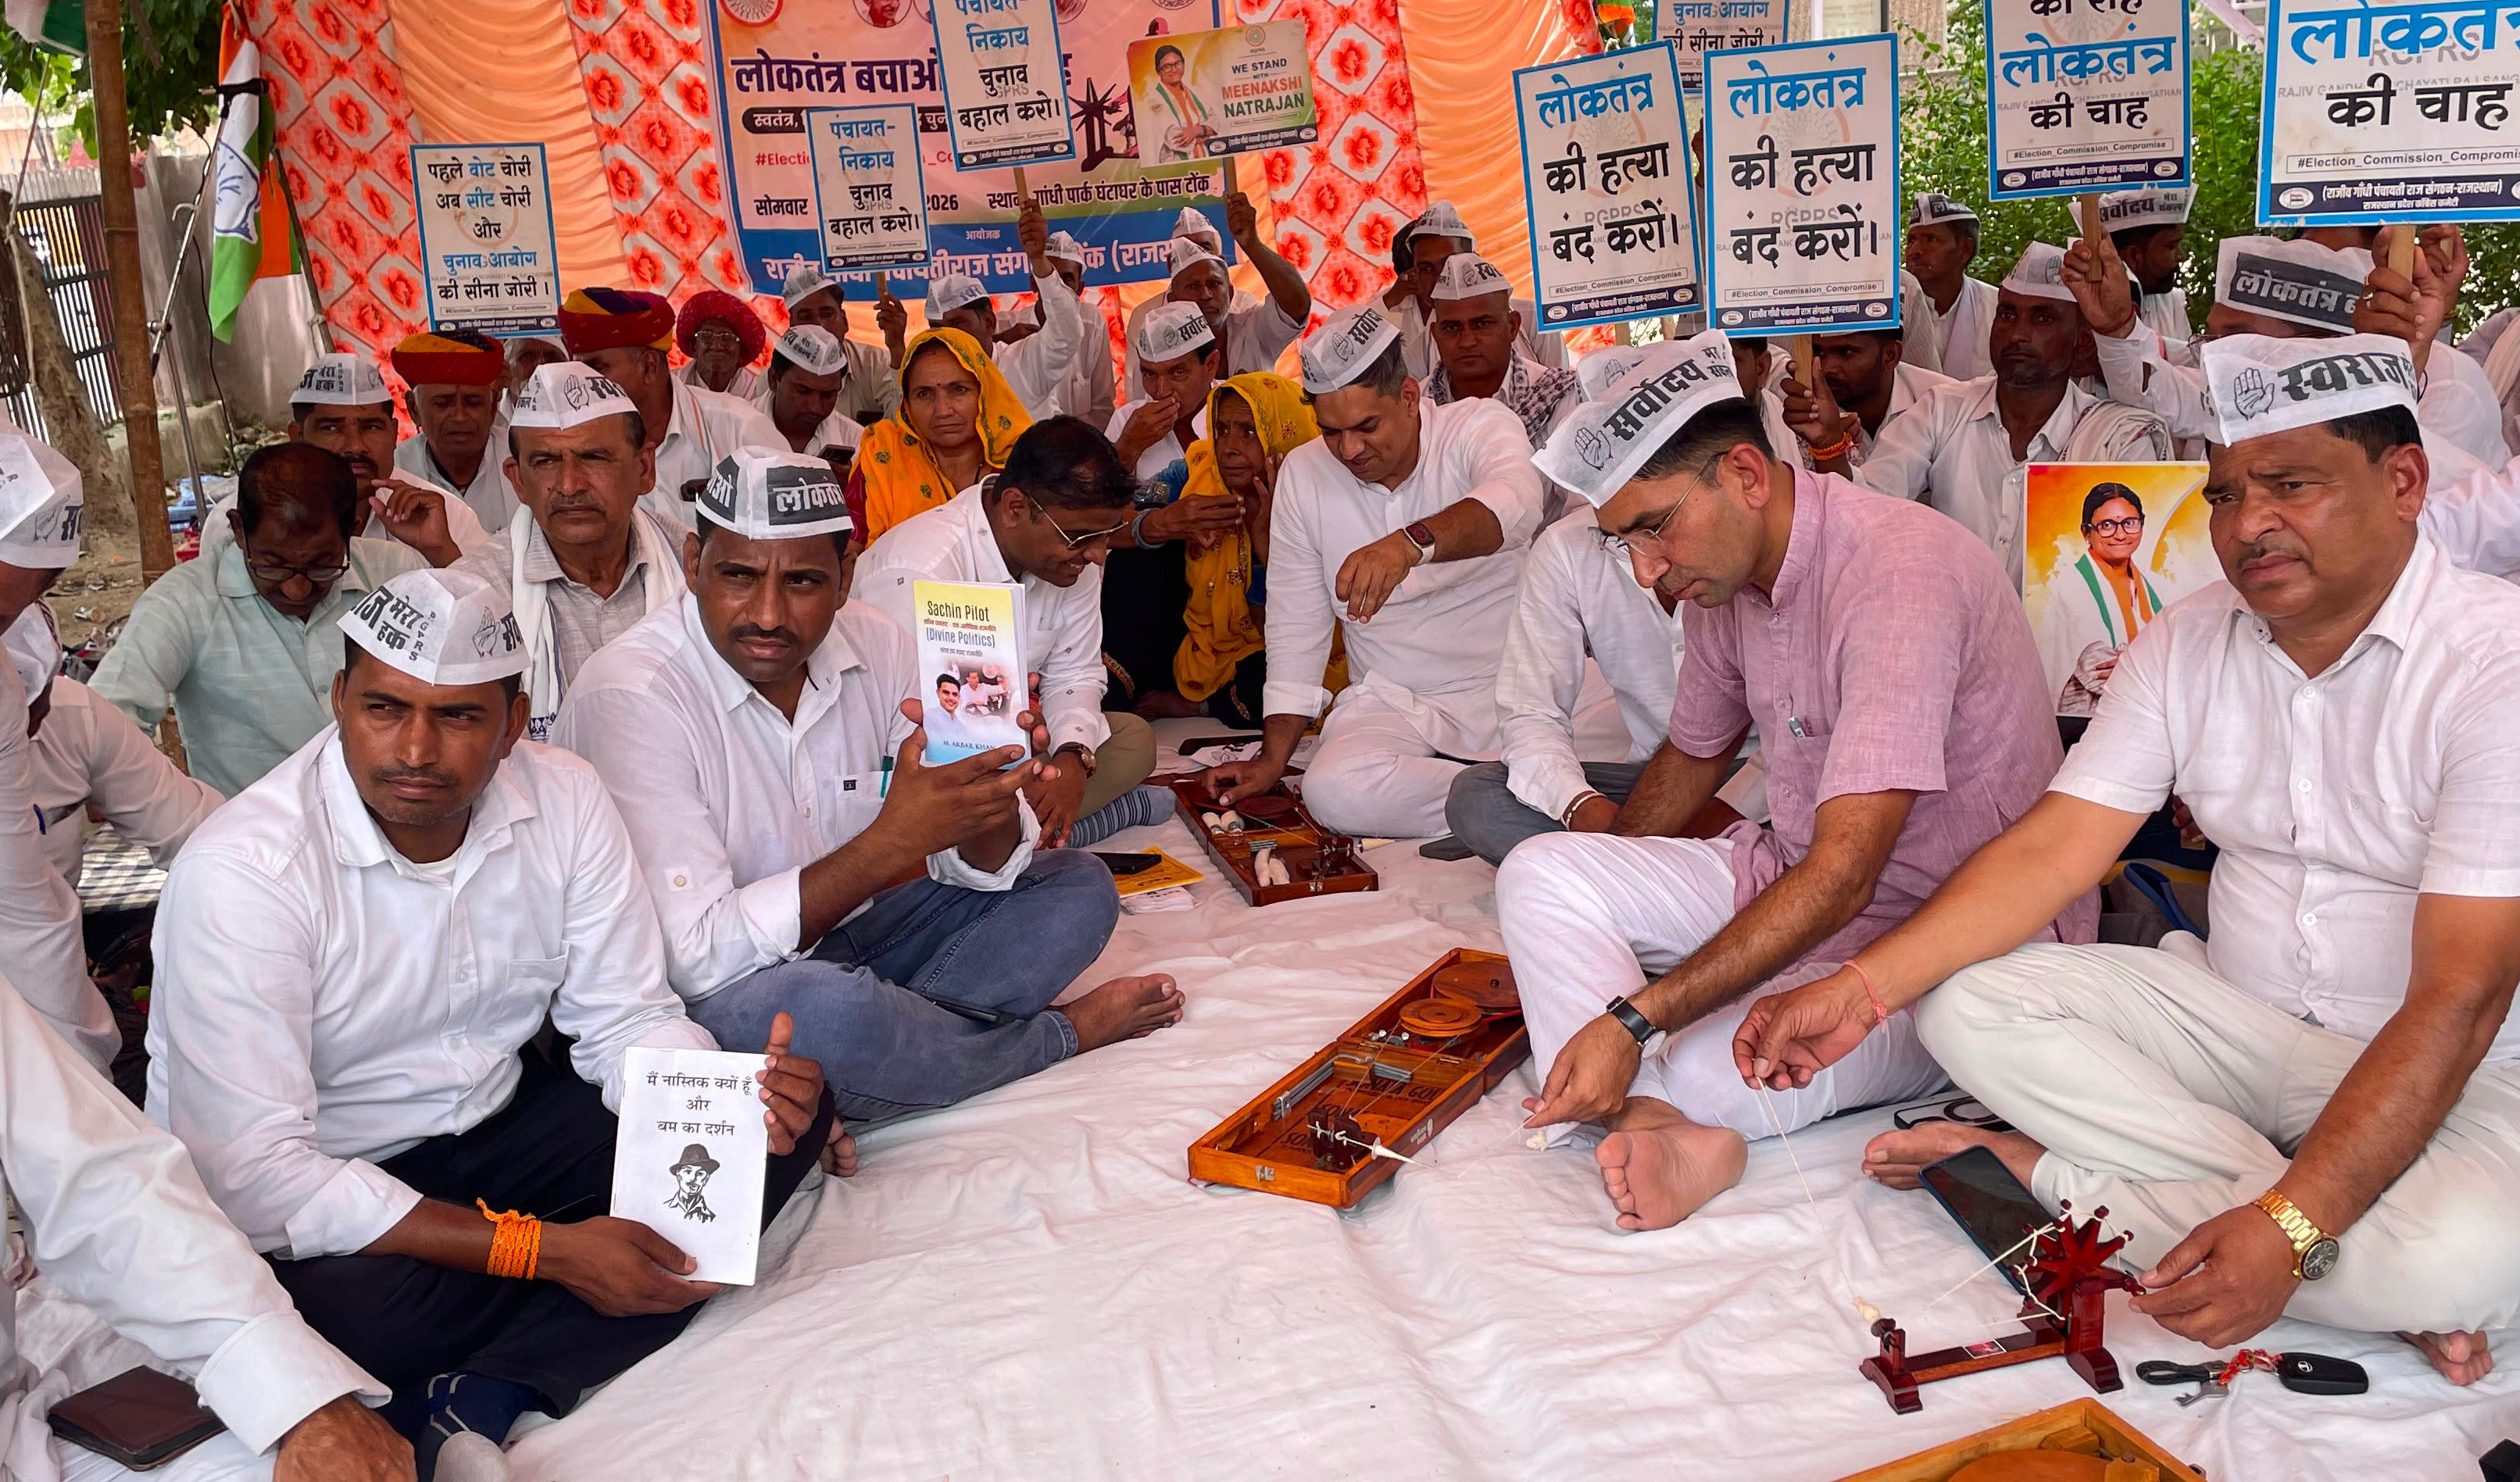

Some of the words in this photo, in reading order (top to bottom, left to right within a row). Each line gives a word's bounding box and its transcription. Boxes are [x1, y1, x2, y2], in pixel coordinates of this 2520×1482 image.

[1673, 2, 1711, 25] चुनाव
[966, 23, 1029, 52] निकाय
[1689, 27, 1725, 52] सीना
[1231, 64, 1249, 73] WE
[1252, 59, 1287, 71] STAND
[1999, 23, 2177, 88] लोकतंत्र
[731, 48, 846, 93] लोकतंत्र
[978, 64, 1028, 96] चुनाव
[1221, 76, 1303, 99] MEENAKSHI
[1535, 61, 1653, 129] लोकतंत्र
[1727, 52, 1867, 120] लोकतंत्र
[2279, 85, 2313, 98] RAJIV
[1224, 93, 1305, 118] NATRAJAN
[2029, 91, 2075, 130] की
[2086, 96, 2150, 130] चाह
[2326, 73, 2397, 127] की
[2415, 83, 2514, 130] चाह
[958, 103, 1010, 132] बहाल
[838, 146, 895, 172] निकाय
[2014, 140, 2166, 159] #Election_Commission_Compromise
[427, 156, 463, 184] पहले
[468, 155, 495, 177] वोट
[500, 155, 531, 178] चोरी
[1543, 141, 1586, 194] की
[1597, 141, 1670, 195] हत्या
[1728, 134, 1778, 191] की
[1791, 144, 1875, 196] हत्या
[435, 193, 461, 209] अब
[466, 186, 495, 209] सीट
[499, 185, 531, 208] चोरी
[754, 194, 809, 216] सोमवार
[1033, 184, 1063, 206] गांधी
[1065, 182, 1093, 204] पार्क
[1096, 180, 1138, 202] घंटाघर
[1140, 177, 1153, 197] के
[1155, 179, 1181, 197] पास
[1183, 172, 1210, 194] टोंक
[849, 184, 892, 210] चुनाव
[2407, 183, 2424, 196] राज
[473, 216, 502, 239] और
[828, 216, 874, 239] बहाल
[965, 228, 1000, 240] आयोजक
[1550, 212, 1595, 264] बंद
[1730, 209, 1781, 269] बंद
[442, 253, 482, 276] चुनाव
[488, 246, 538, 268] आयोग
[437, 278, 459, 299] की
[463, 277, 499, 300] सीना
[504, 276, 538, 298] जोरी
[1555, 270, 1682, 295] #Election_Commission_Compromise
[1732, 284, 1877, 298] #Election_Commission_Compromise
[2235, 269, 2343, 312] लोकतंत्र
[1178, 314, 1210, 342] सर्वोद
[2277, 352, 2409, 402] स्वराज
[1603, 359, 1709, 441] सर्वोदय
[389, 595, 424, 630] मेरा
[928, 600, 962, 620] Sachin
[965, 605, 990, 622] Pilot
[377, 620, 410, 650] हक
[958, 630, 995, 648] Politics)
[952, 741, 973, 749] AKBAR
[646, 1071, 657, 1086] मैं
[662, 1072, 710, 1088] नास्तिक
[714, 1074, 738, 1090] क्यों
[686, 1095, 711, 1112] और
[656, 1120, 677, 1133] बम
[681, 1122, 701, 1134] का
[704, 1120, 735, 1136] दर्शन
